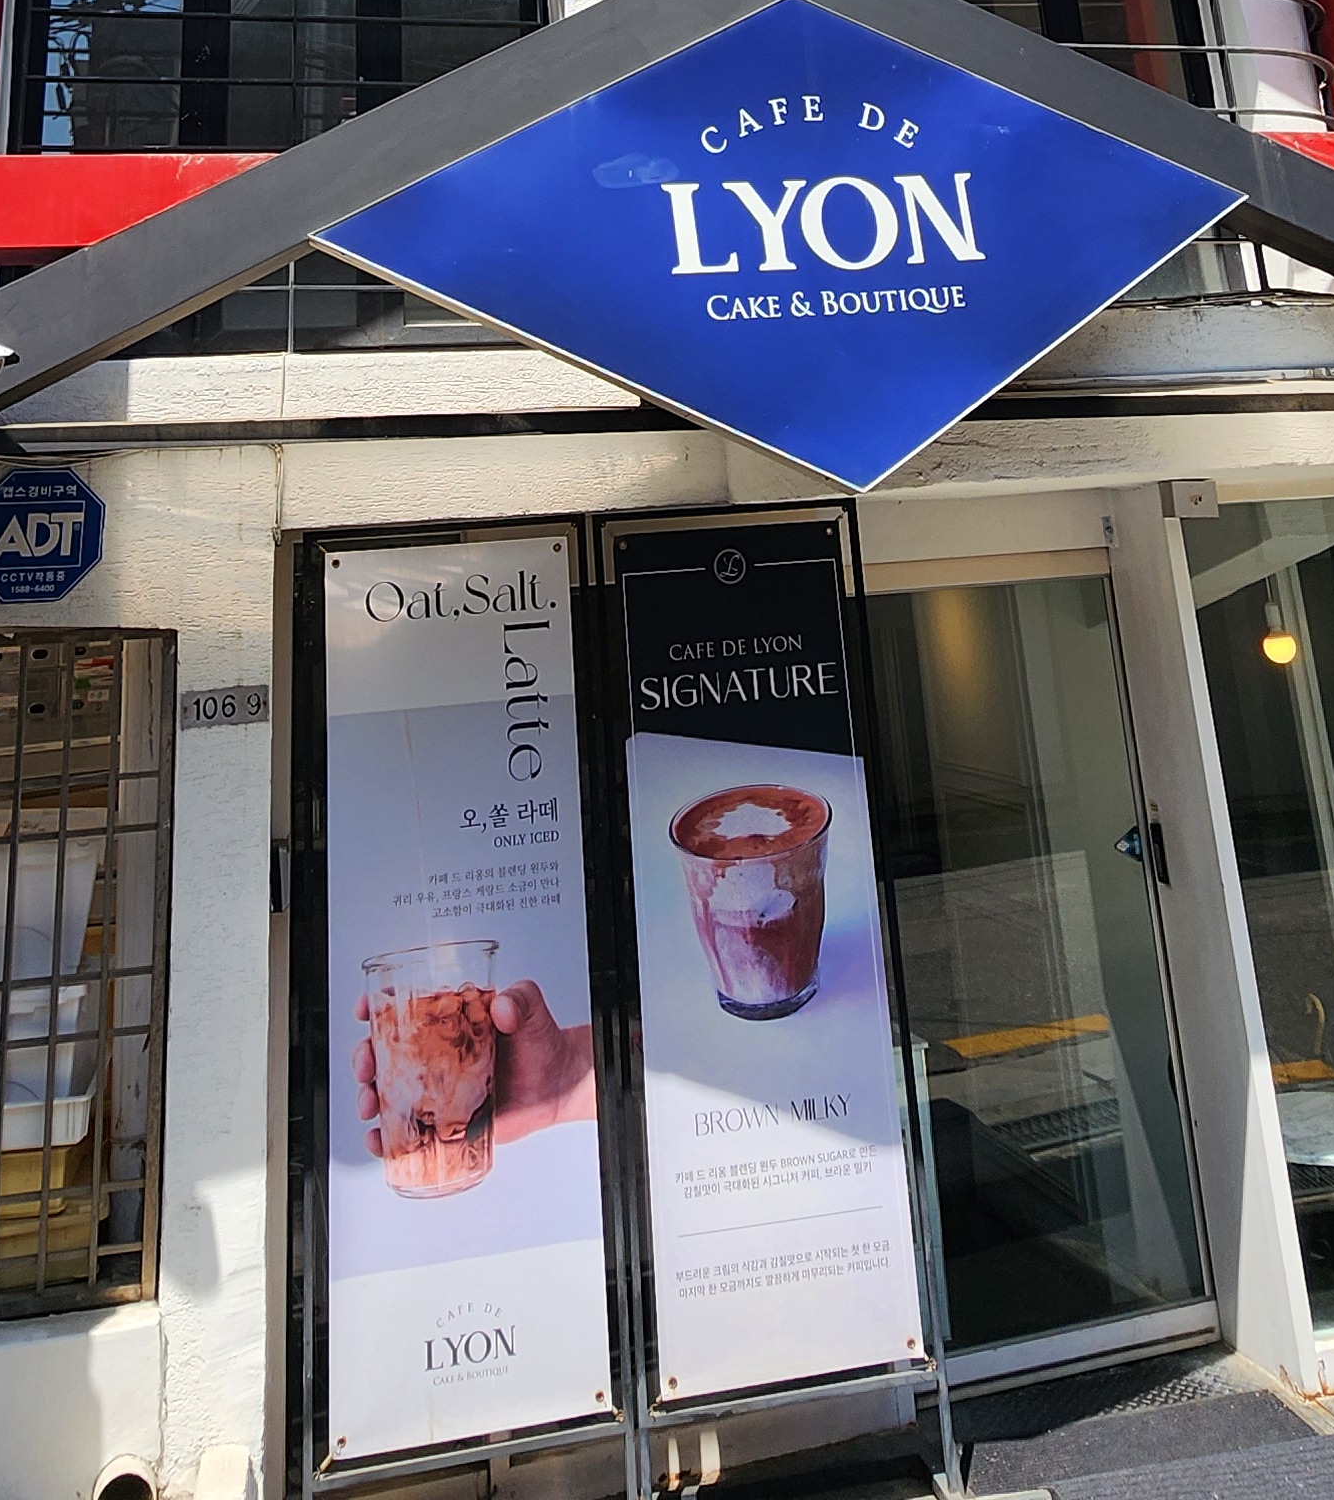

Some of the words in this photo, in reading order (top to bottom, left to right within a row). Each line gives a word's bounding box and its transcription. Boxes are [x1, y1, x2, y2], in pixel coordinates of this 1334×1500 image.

[700, 94, 825, 155] CAFE
[858, 101, 920, 150] DE
[661, 172, 986, 276] LYON
[790, 289, 815, 319] &
[2, 484, 78, 498] 캡스경비구역
[10, 584, 55, 593] 1588-6400
[669, 639, 716, 662] CAFE
[722, 637, 748, 657] DE
[752, 634, 803, 655] LYON
[502, 619, 552, 782] Latte
[639, 661, 840, 712] SIGNATURE
[517, 797, 559, 825] 라떼
[493, 834, 526, 848] ONLY
[530, 830, 560, 844] ICED
[428, 873, 448, 886] 카페
[451, 873, 462, 882] 드
[465, 867, 494, 882] 리옹의
[498, 863, 526, 878] 블렌딩
[529, 860, 559, 873] 원두와
[393, 893, 412, 906] 귀리
[441, 887, 473, 901] 프랑스
[508, 879, 537, 892] 소금이
[540, 877, 560, 890] 만나
[432, 903, 472, 918] 고소함이
[475, 898, 515, 912] 극대화된
[694, 1102, 779, 1137] BROWN
[789, 1092, 852, 1123] MILKY
[675, 1169, 694, 1184] 카페
[697, 1169, 706, 1180] 드
[708, 1165, 727, 1179] 리옹
[730, 1160, 757, 1176] 블렌딩
[760, 1159, 778, 1173] 원두
[780, 1154, 816, 1169] BROWN
[817, 1147, 857, 1164] SUGAR로
[859, 1144, 878, 1158] 만든
[683, 1182, 721, 1199] 감칠맛이
[723, 1177, 760, 1193] 극대화된
[763, 1170, 799, 1187] 시그니처
[825, 1163, 852, 1178] 브라운
[854, 1160, 872, 1175] 밀키
[676, 1267, 711, 1283] 부드러운
[713, 1262, 739, 1277] 크림의
[741, 1257, 768, 1273] 식감과
[770, 1251, 813, 1268] 감칠맛으로
[815, 1246, 849, 1261] 시작되는
[851, 1244, 860, 1257] 첫
[862, 1242, 871, 1255] 한
[679, 1283, 706, 1299] 마지막
[708, 1281, 717, 1296] 한
[719, 1275, 763, 1293] 모금까지도
[765, 1270, 801, 1287] 깔끔하게
[802, 1263, 845, 1280] 마무리되는
[436, 1302, 475, 1328] CAFE
[484, 1303, 503, 1318] DE
[424, 1325, 517, 1372] LYON
